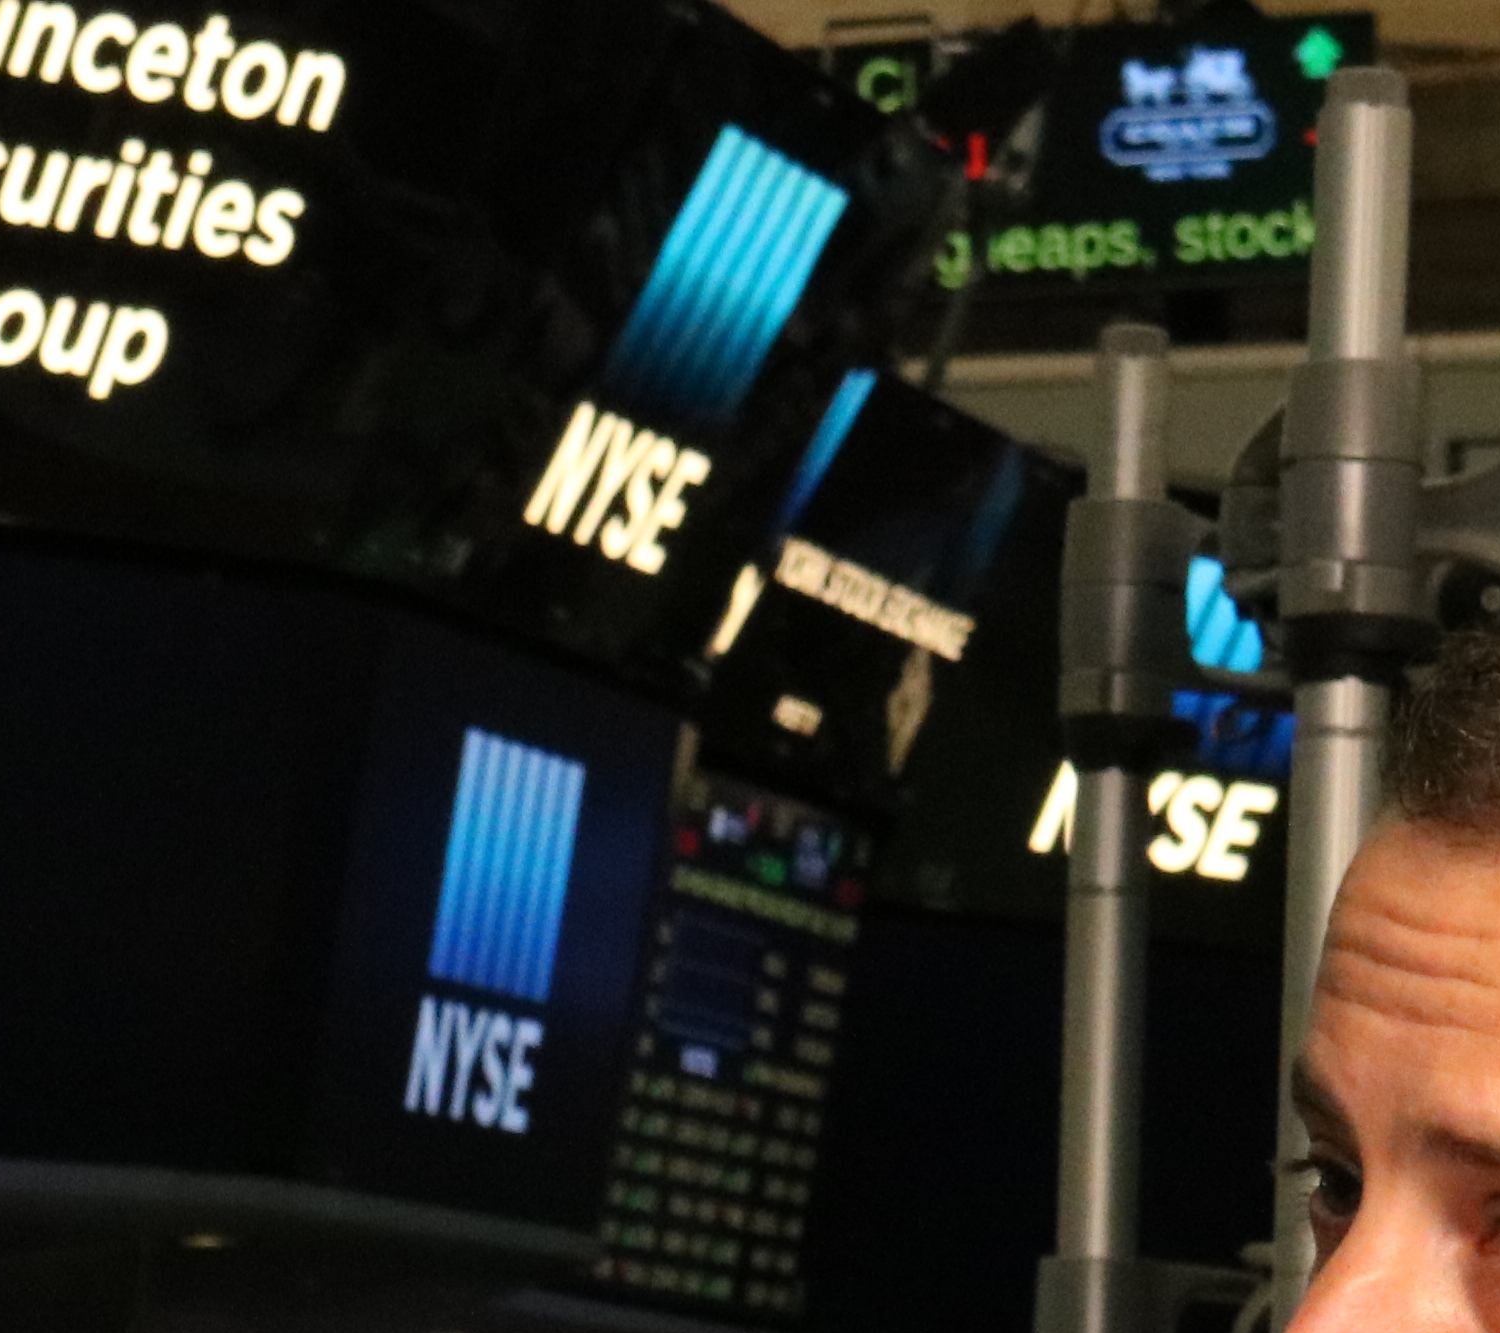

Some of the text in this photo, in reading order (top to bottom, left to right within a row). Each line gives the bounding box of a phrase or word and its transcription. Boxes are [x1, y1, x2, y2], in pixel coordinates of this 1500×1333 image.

[522, 401, 712, 576] NYSE
[1028, 760, 1278, 881] NSE
[404, 995, 543, 1133] NYSE
